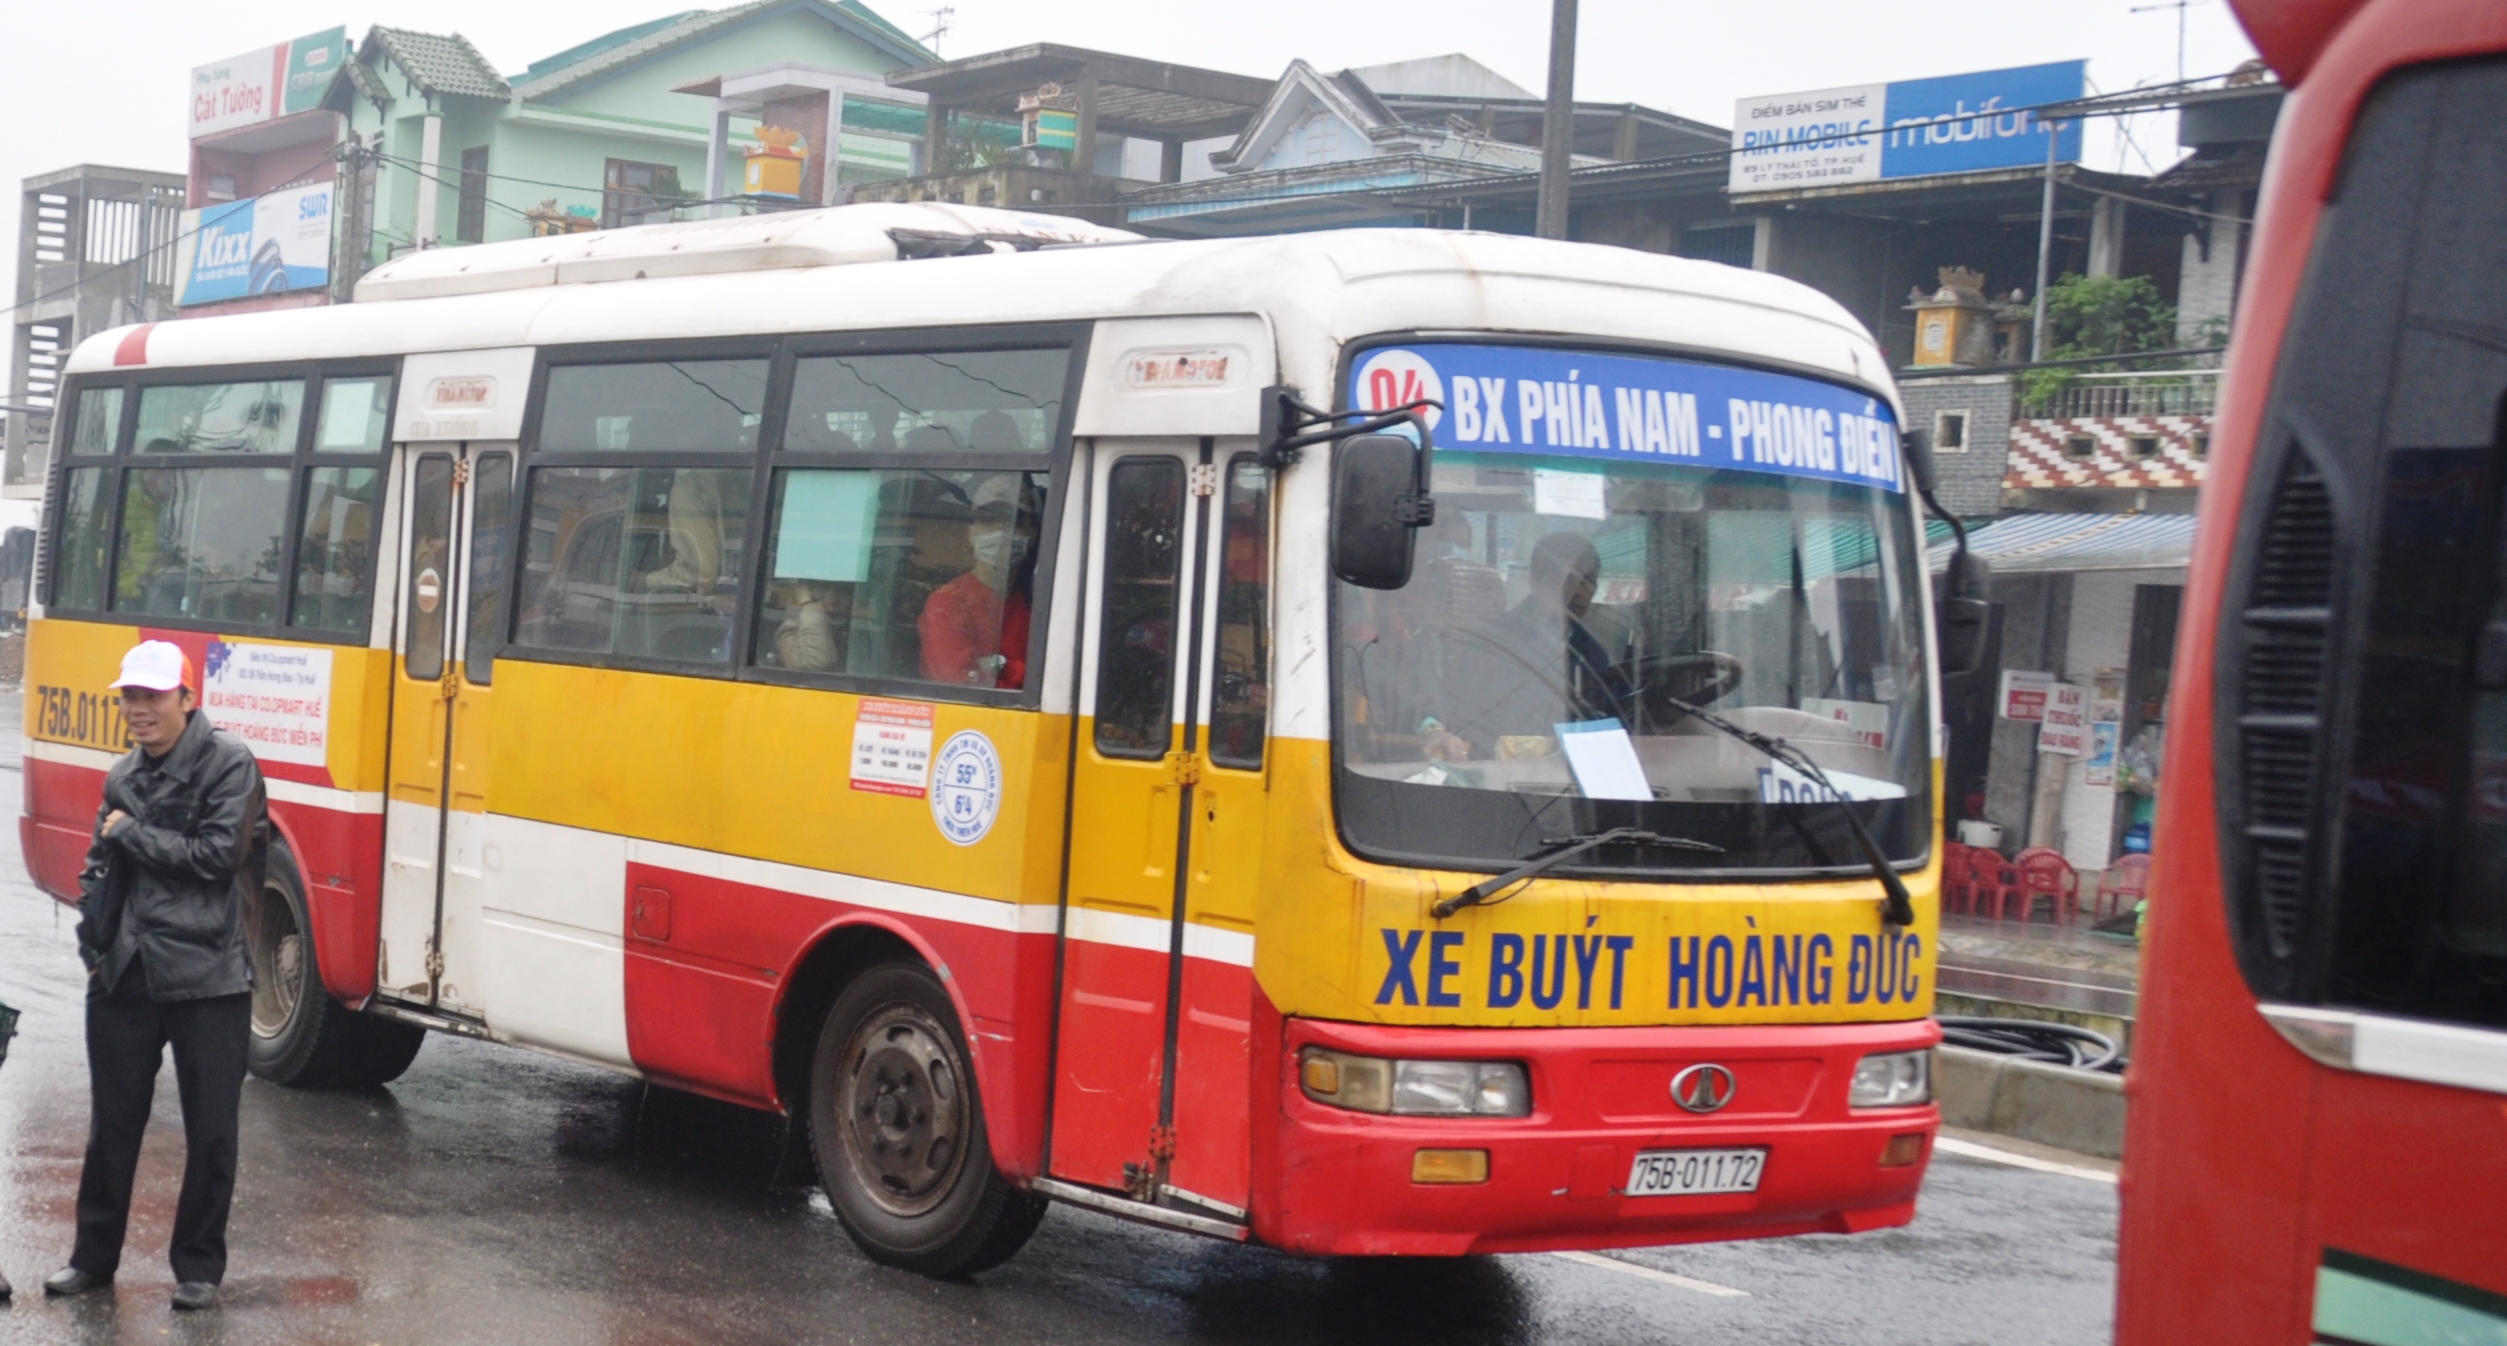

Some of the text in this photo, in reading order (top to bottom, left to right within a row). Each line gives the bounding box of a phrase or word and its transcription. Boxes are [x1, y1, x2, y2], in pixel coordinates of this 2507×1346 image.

[194, 82, 262, 123] Cát Tường
[1814, 98, 1839, 112] SIM
[1742, 118, 1870, 157] RIN MOBILE
[1743, 164, 1757, 173] 89
[1772, 170, 1802, 180] 0905
[197, 225, 251, 269] Kixx
[1452, 375, 1511, 444] BX
[1518, 369, 1611, 450] PHÍA
[1615, 386, 1701, 457] NAM
[1729, 398, 1836, 471] PHONG
[1375, 928, 1465, 1008] XE
[1486, 915, 1634, 1010] BUÝT
[1668, 915, 1834, 1010] HOÀNG
[1634, 1155, 1760, 1192] 75B-011.72
